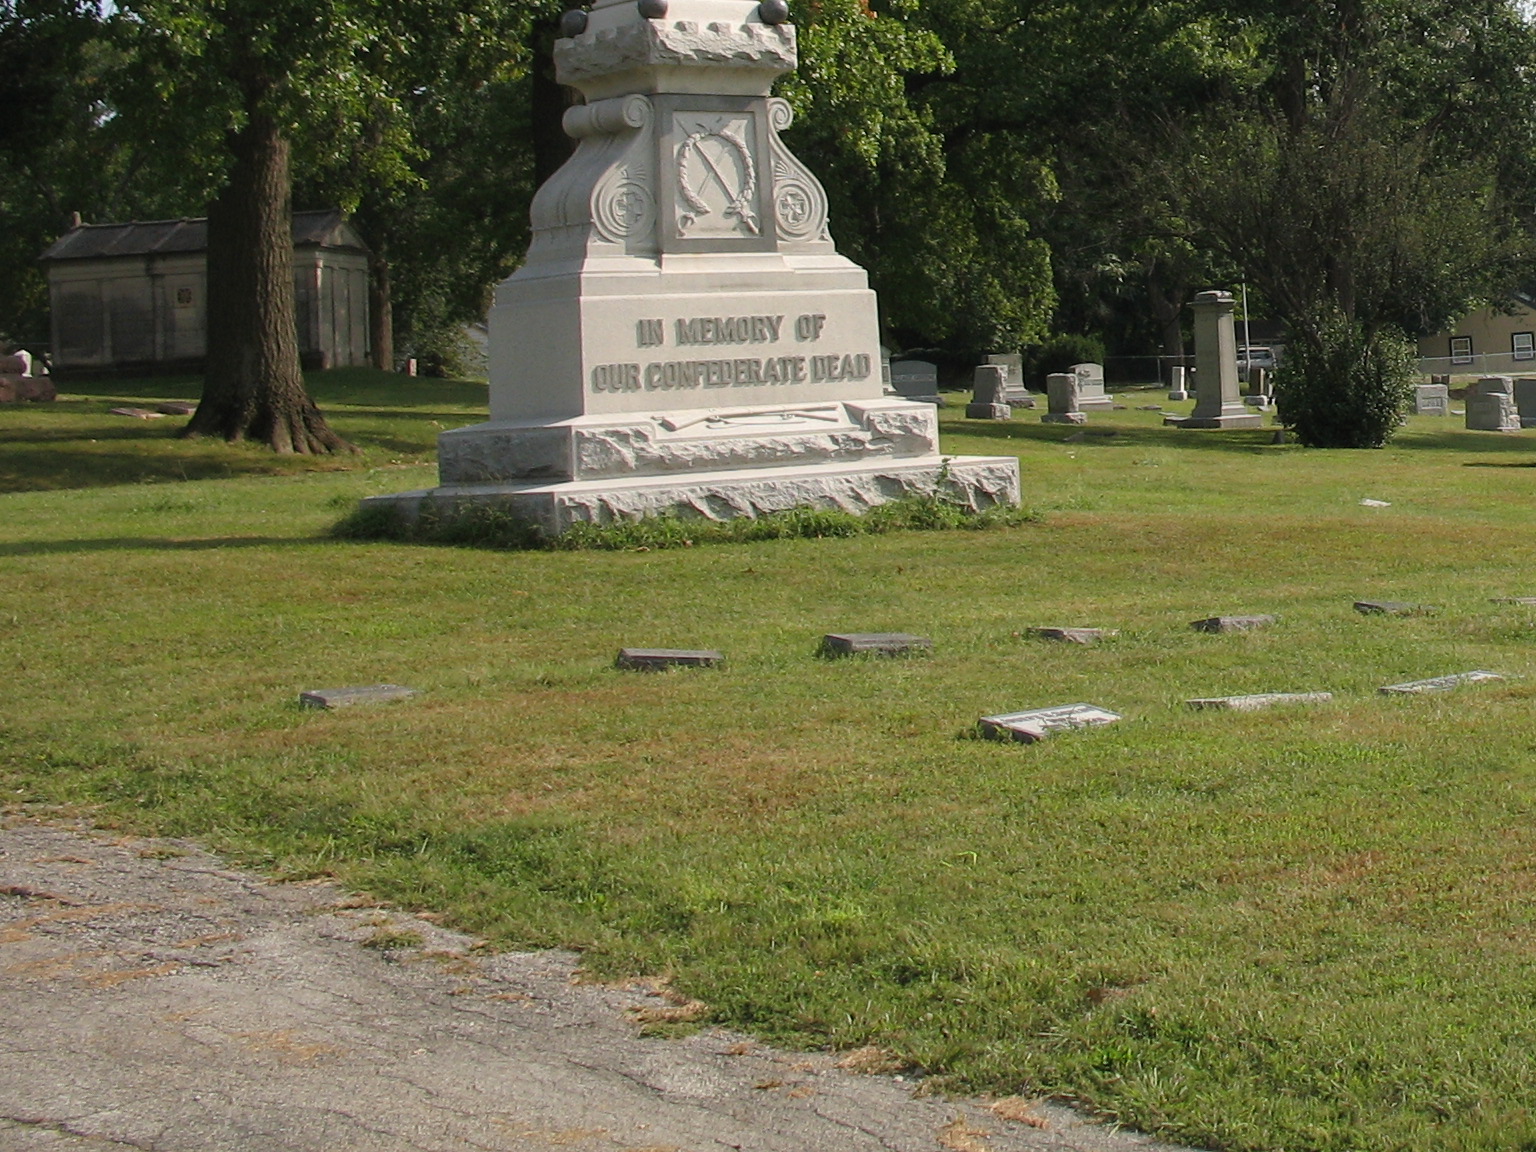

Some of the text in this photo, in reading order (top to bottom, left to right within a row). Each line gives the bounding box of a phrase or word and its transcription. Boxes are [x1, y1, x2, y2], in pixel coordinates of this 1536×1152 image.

[637, 314, 826, 346] IN MEMORY OF
[592, 353, 871, 391] OUR CONFEDERATE DEAD
